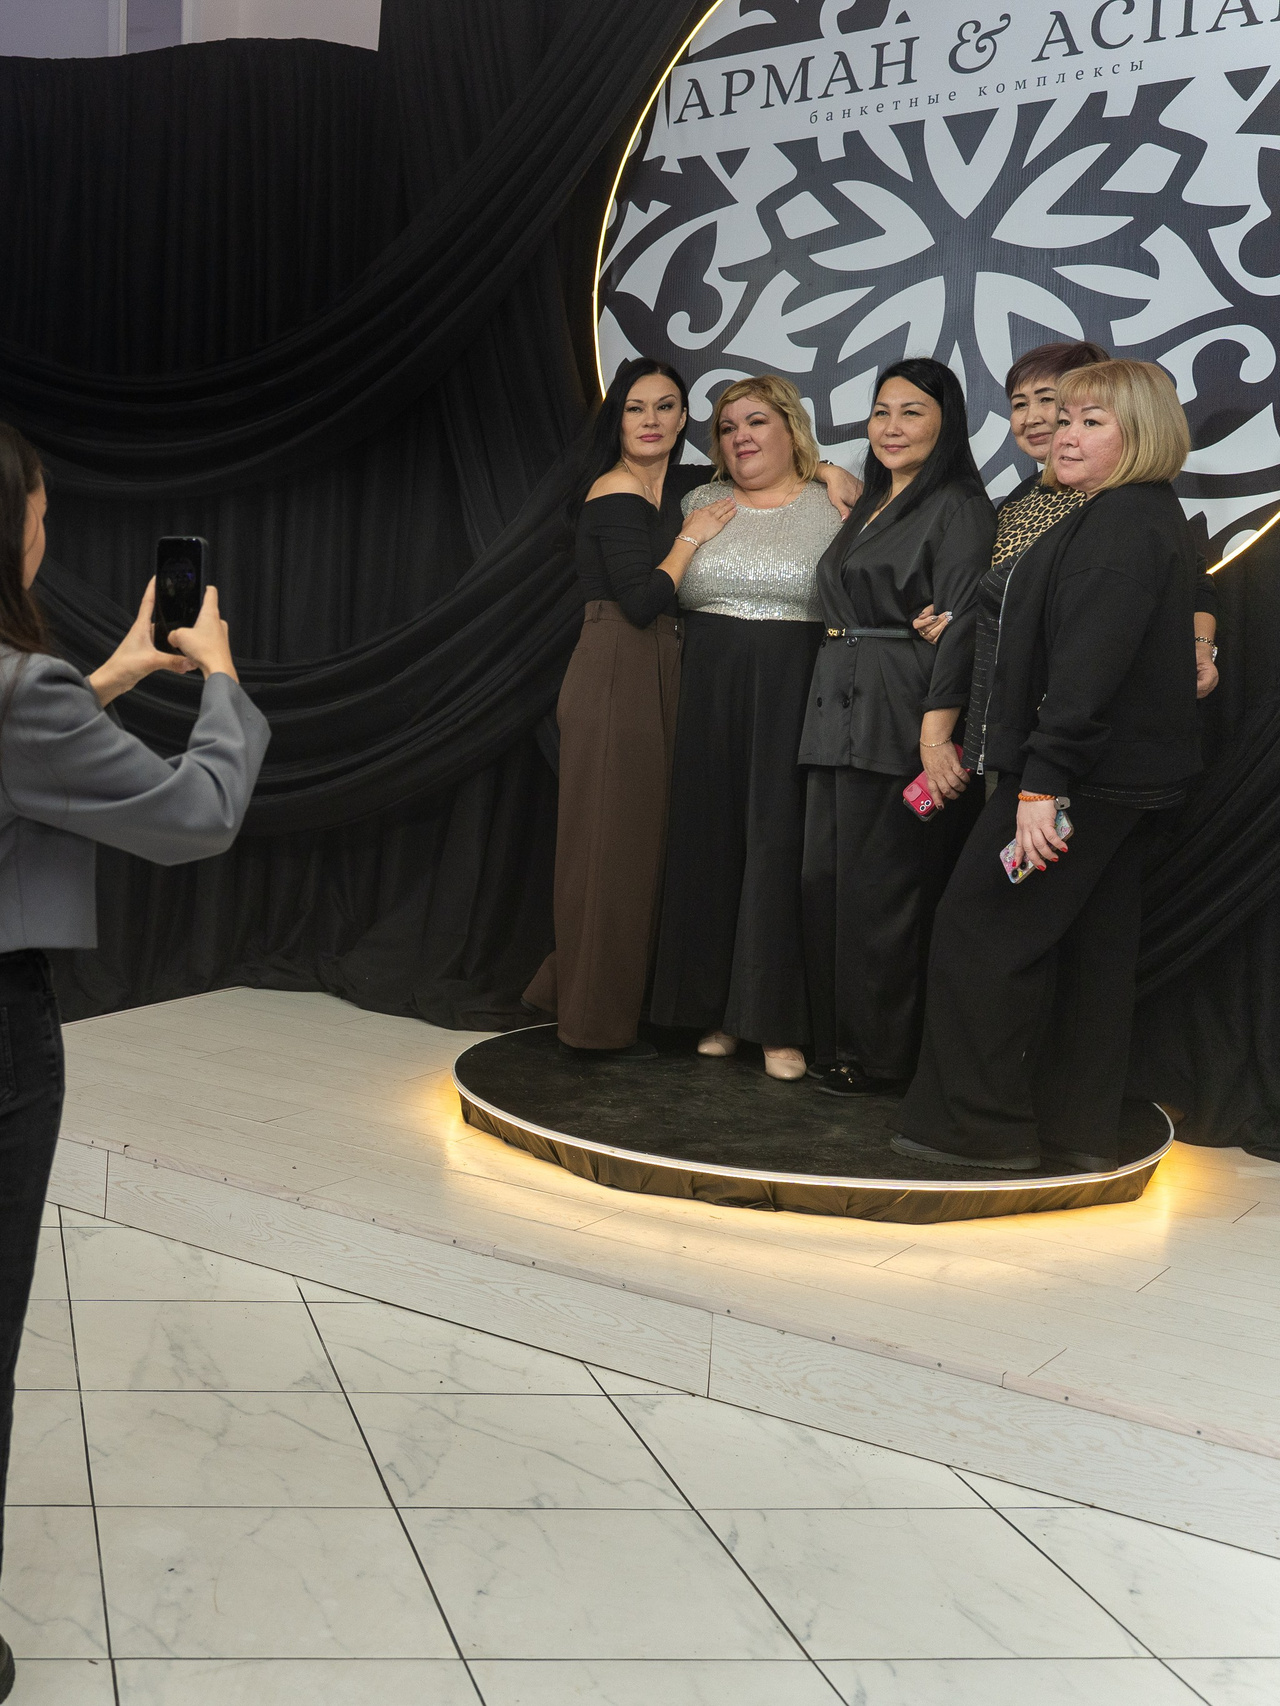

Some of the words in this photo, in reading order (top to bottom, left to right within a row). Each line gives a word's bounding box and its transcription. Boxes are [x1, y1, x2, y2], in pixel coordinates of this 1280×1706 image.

[673, 36, 920, 124] АРМАН
[948, 13, 1011, 74] &
[1031, 0, 1280, 62] АСПА
[809, 89, 957, 124] банкетные
[977, 59, 1144, 97] комплексы
